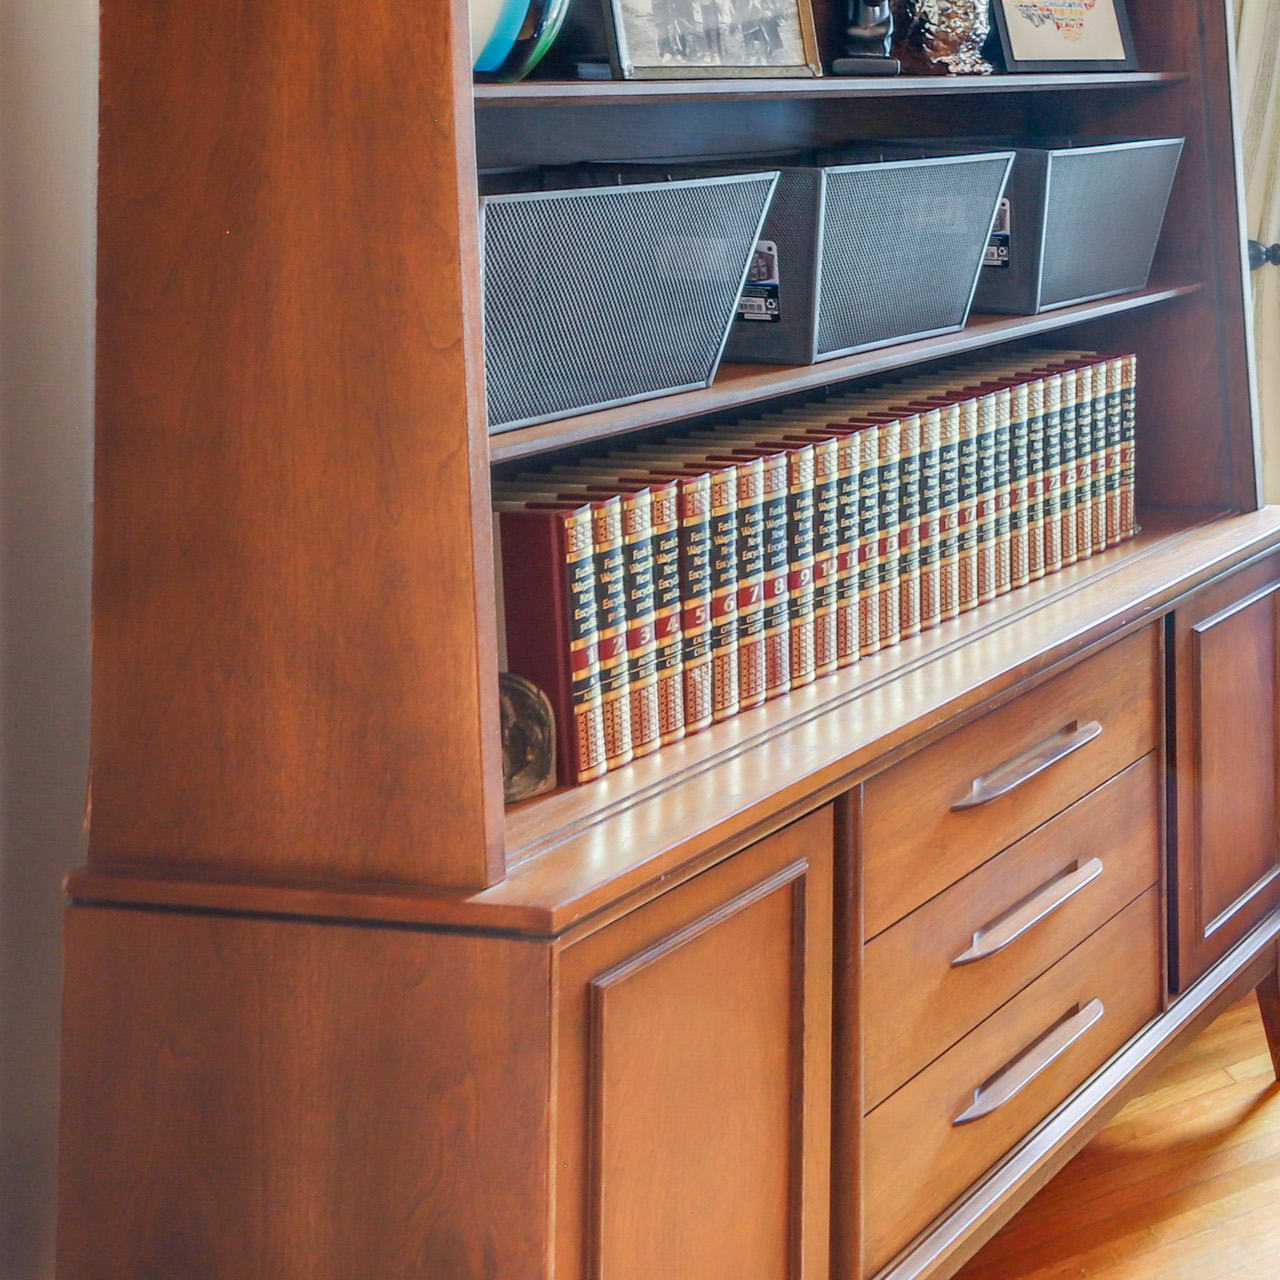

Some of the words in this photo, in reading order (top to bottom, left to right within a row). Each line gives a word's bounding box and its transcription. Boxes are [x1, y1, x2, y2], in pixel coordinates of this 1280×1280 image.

[945, 515, 957, 529] 16
[800, 570, 810, 585] 9
[750, 585, 760, 603] 7
[774, 578, 784, 594] 8
[723, 597, 735, 612] 6
[666, 616, 678, 632] 4
[695, 608, 706, 624] 5
[640, 628, 650, 646] 3
[612, 638, 624, 656] 2
[586, 649, 596, 665] 1
